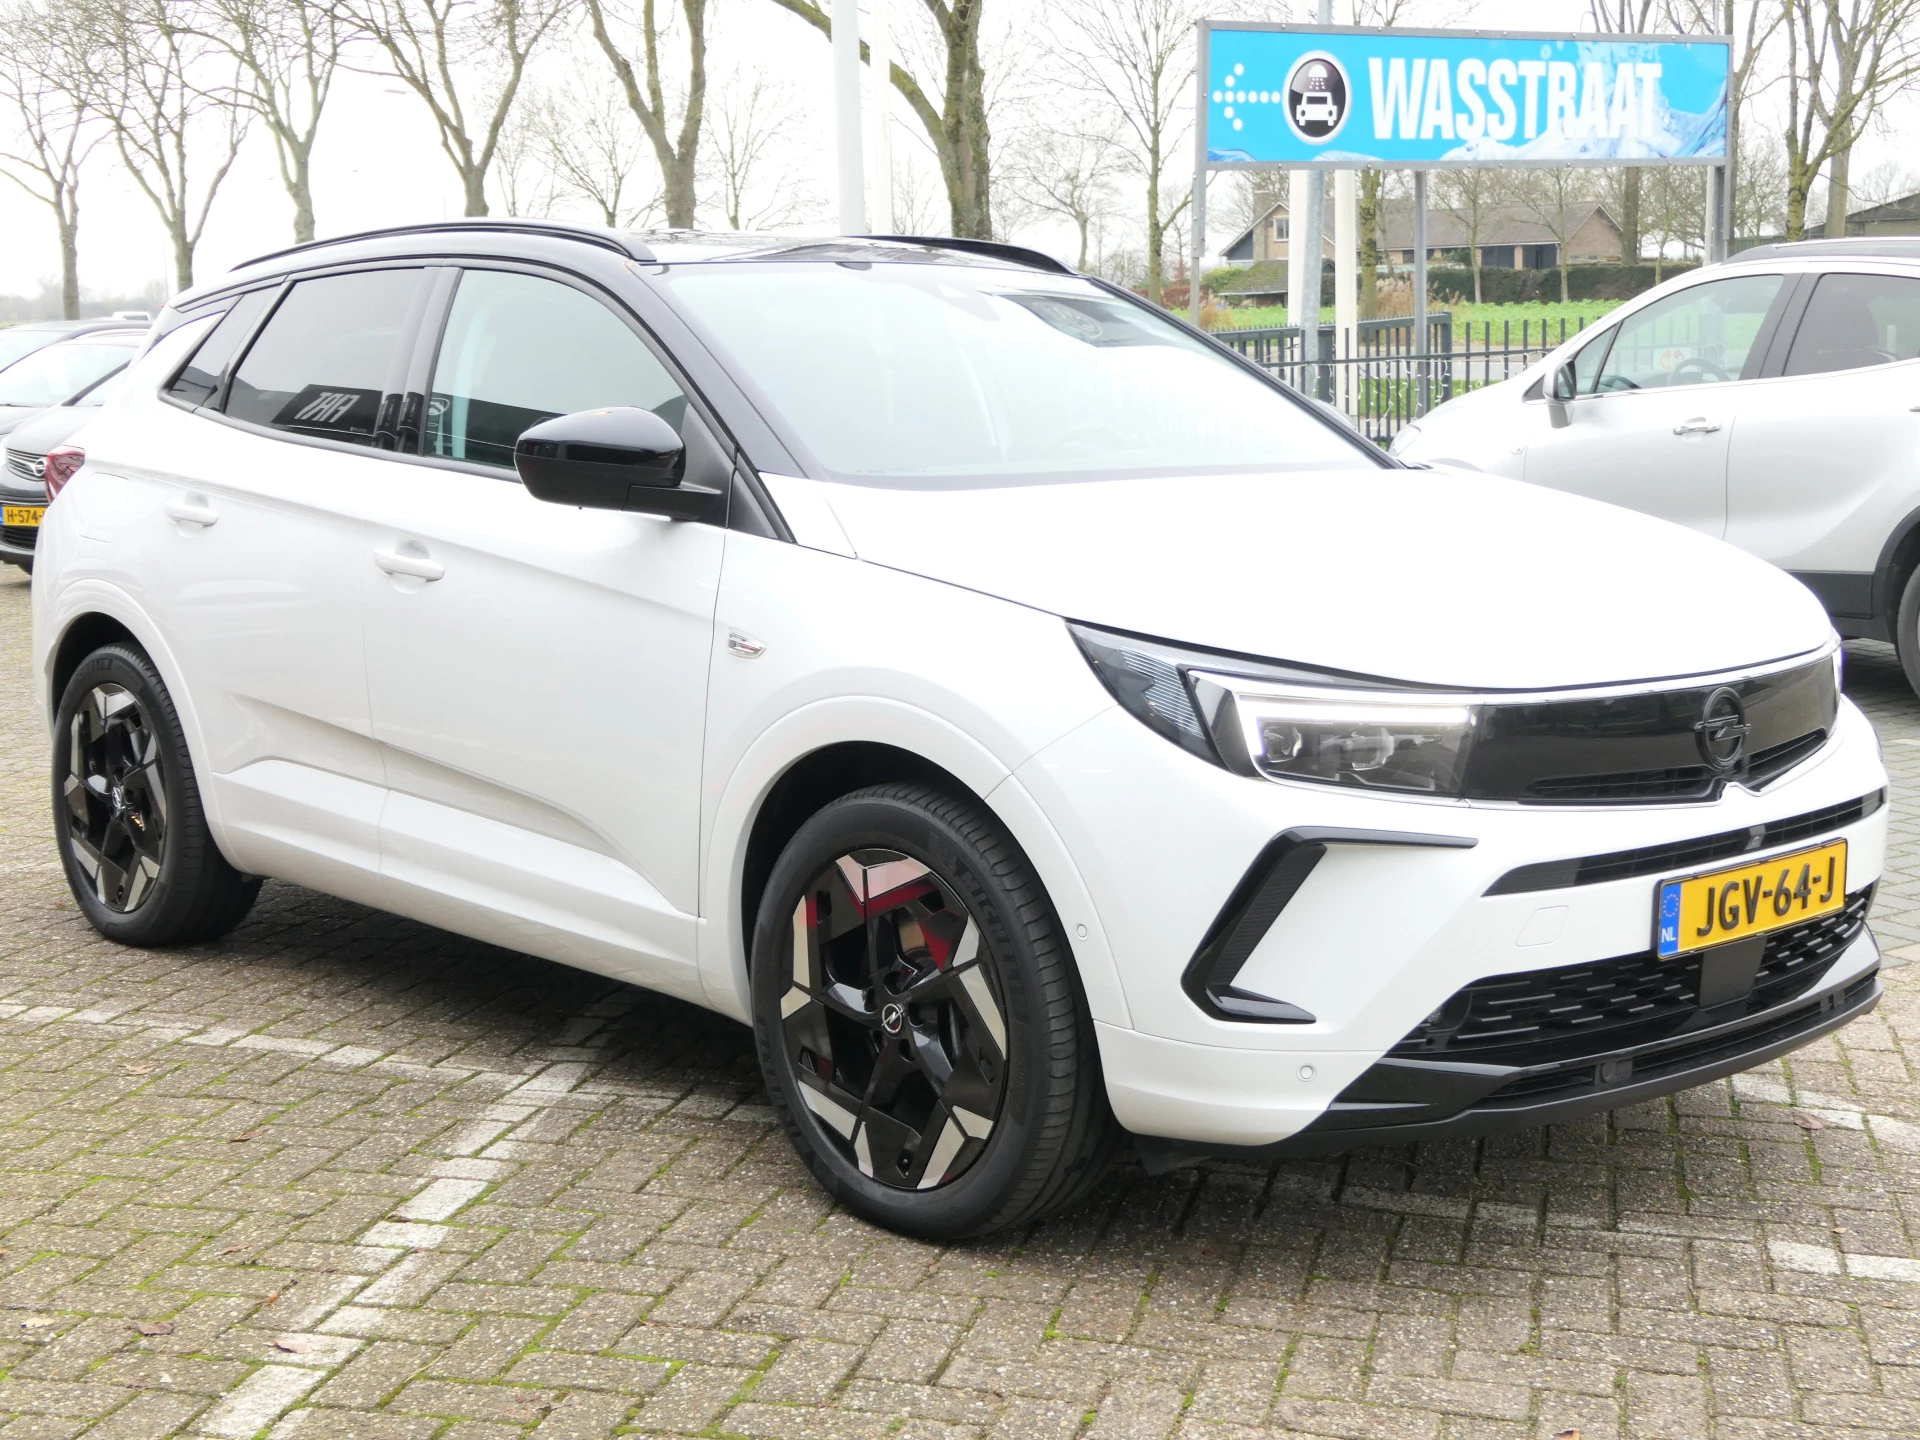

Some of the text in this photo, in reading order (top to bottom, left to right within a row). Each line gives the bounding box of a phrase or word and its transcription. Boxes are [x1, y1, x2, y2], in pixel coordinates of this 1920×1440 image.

[1369, 57, 1662, 139] WASSTRAAT
[6, 508, 45, 524] H-574-
[1697, 856, 1836, 937] JGV-64-J
[1661, 927, 1677, 942] NL
